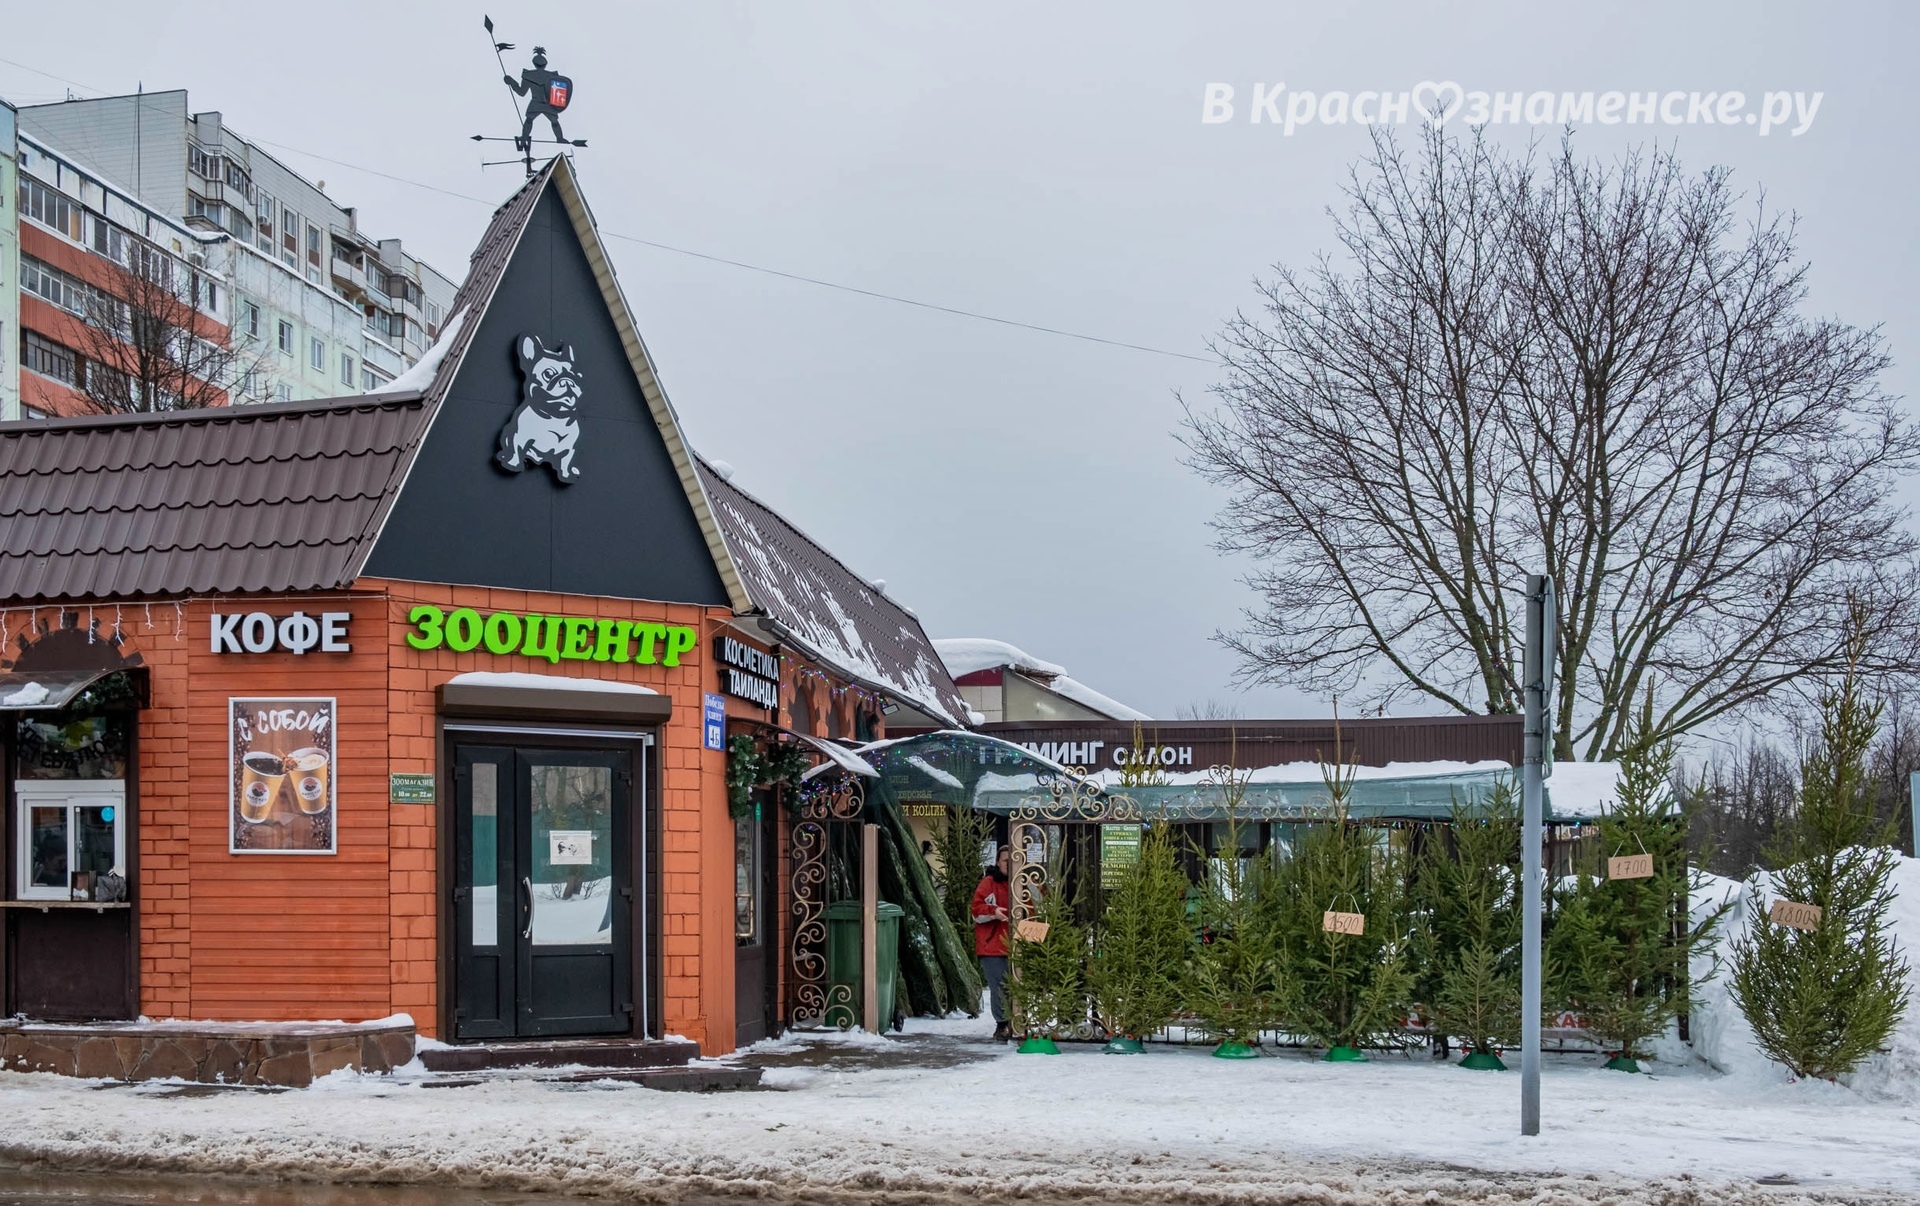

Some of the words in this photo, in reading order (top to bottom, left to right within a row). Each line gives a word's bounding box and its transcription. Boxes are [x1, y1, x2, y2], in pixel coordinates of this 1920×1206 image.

[210, 610, 352, 655] КОФЕ
[405, 605, 697, 667] ЗООЦЕНТР
[724, 636, 779, 681] КОСМЕТИКА
[729, 668, 778, 710] ТАИЛАНДА
[238, 717, 253, 741] С
[257, 708, 330, 734] СОБОЙ
[1615, 859, 1647, 876] 1700
[1776, 906, 1811, 925] 1800
